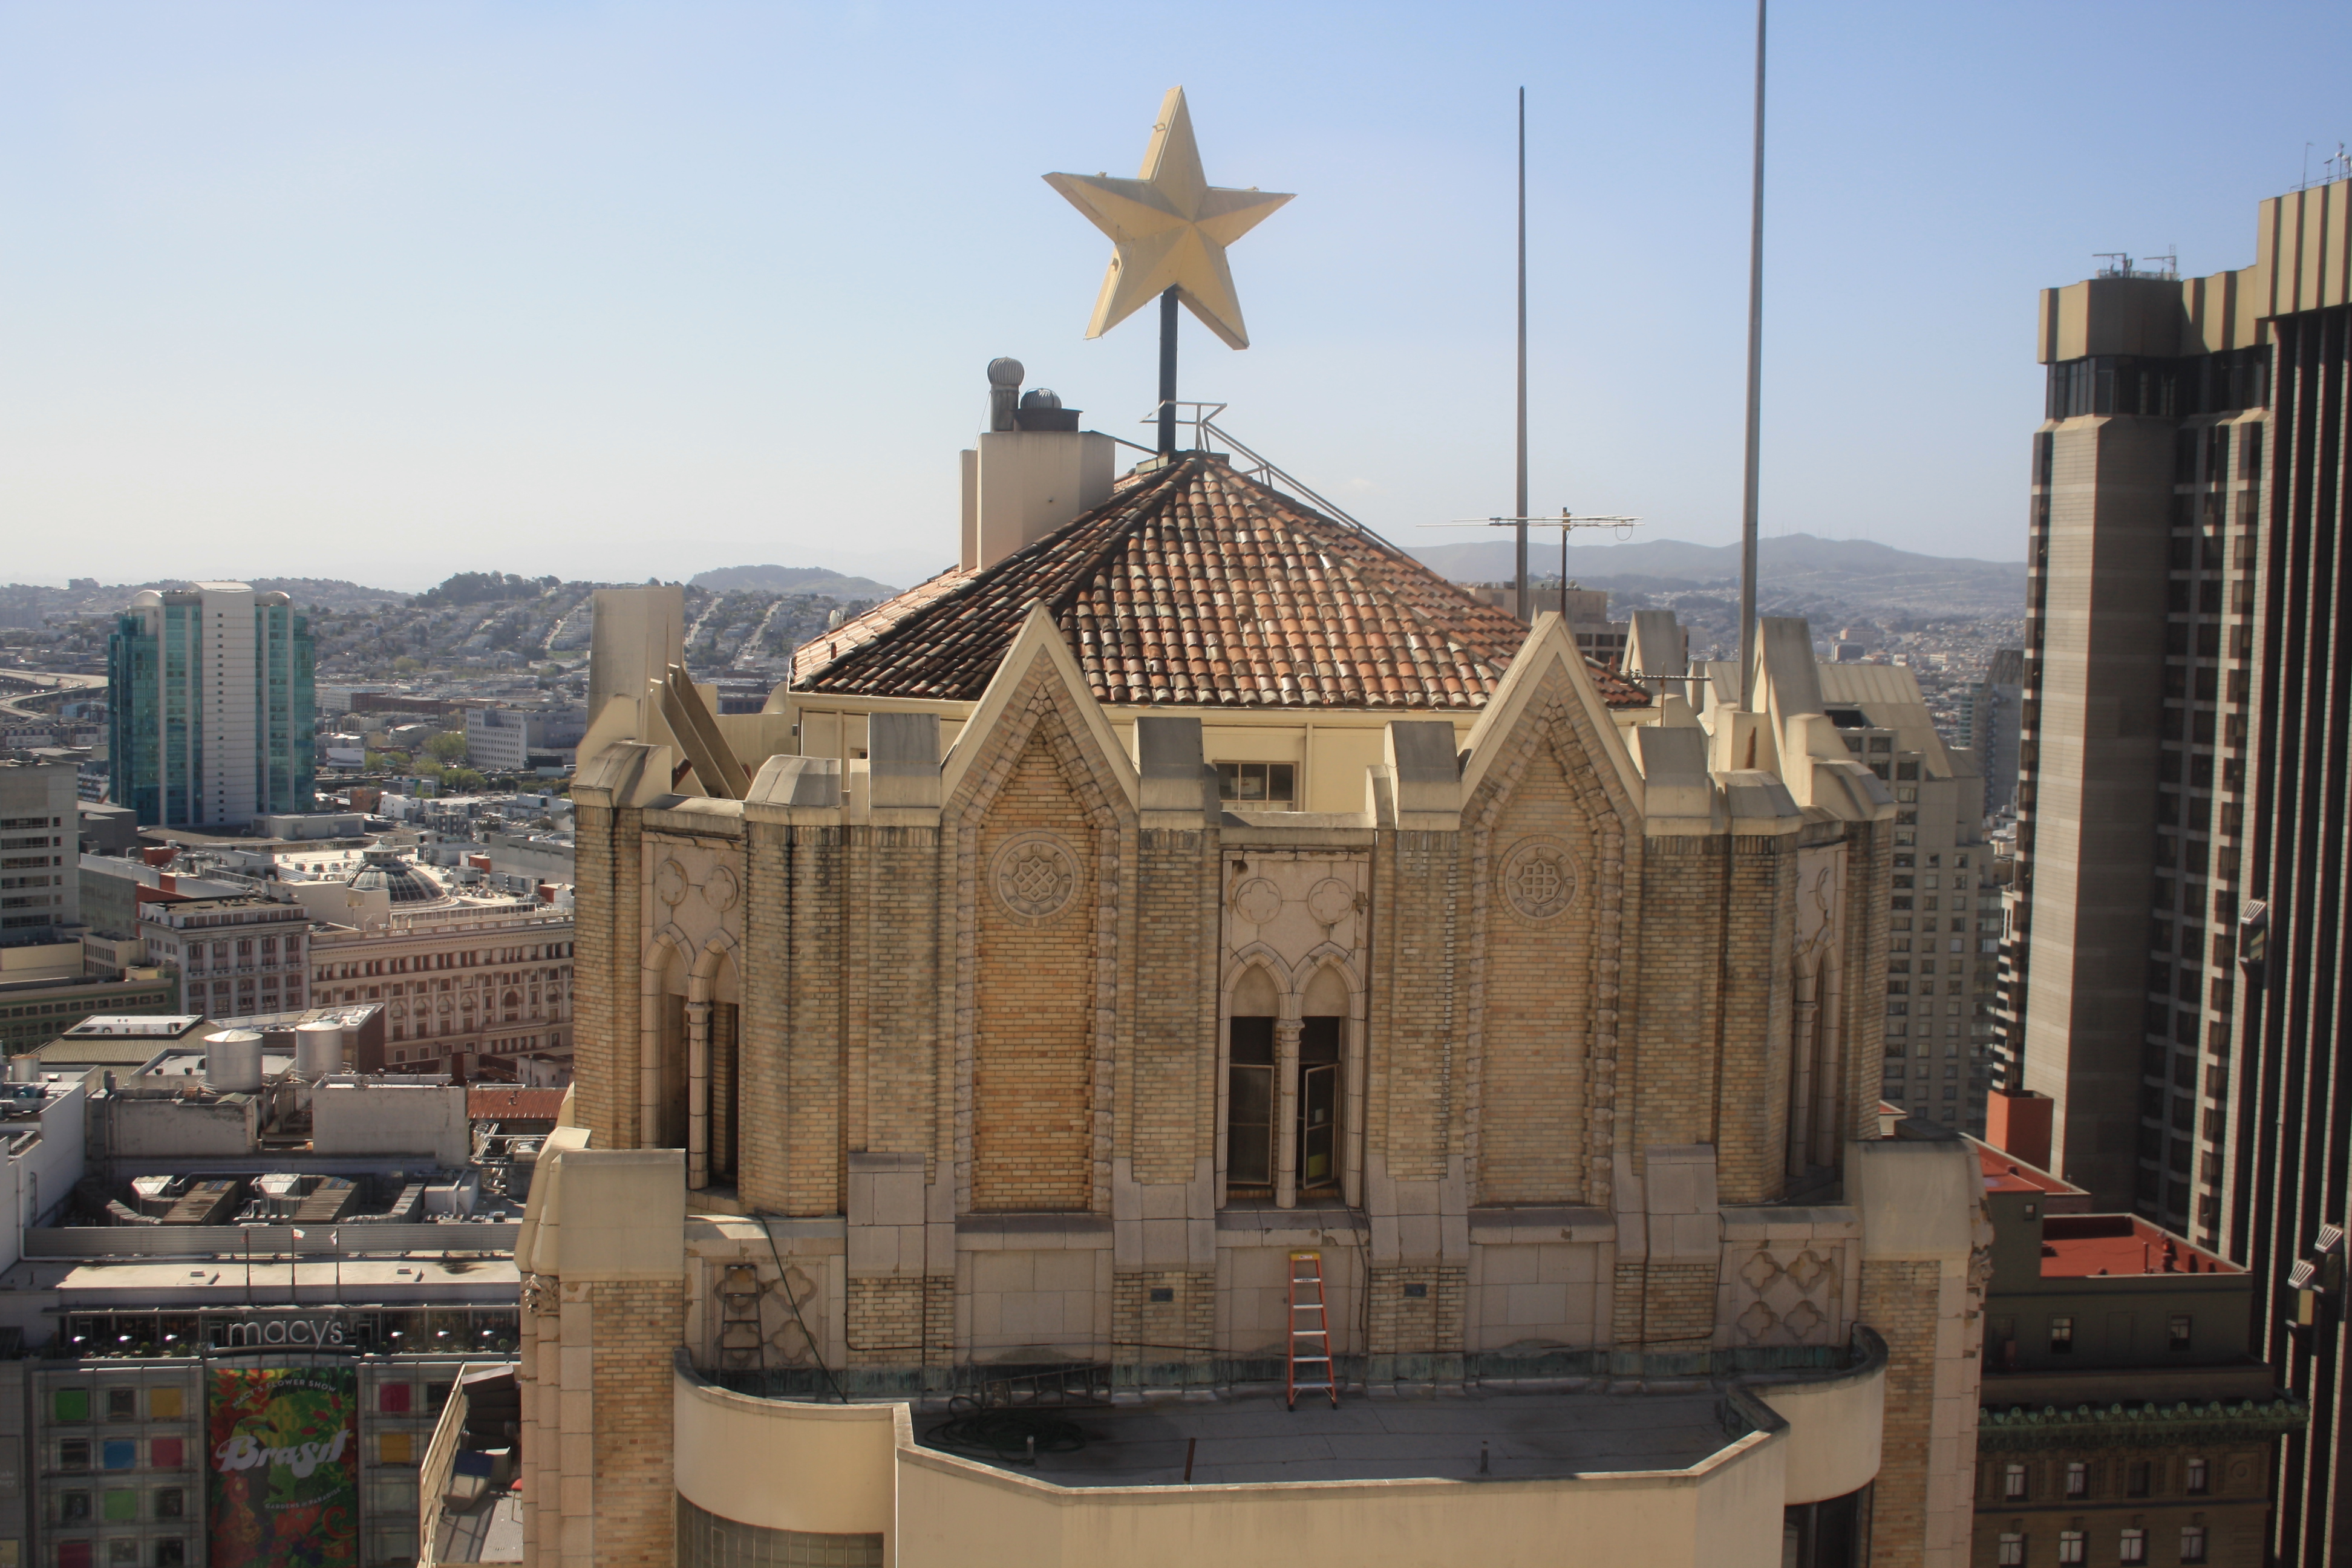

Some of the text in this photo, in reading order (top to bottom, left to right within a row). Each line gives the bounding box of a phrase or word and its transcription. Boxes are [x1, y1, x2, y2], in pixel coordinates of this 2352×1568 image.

[232, 1379, 336, 1408] MACY'S FLOWER SHOW
[216, 1429, 351, 1478] Brasil
[309, 1487, 341, 1504] PARADISE
